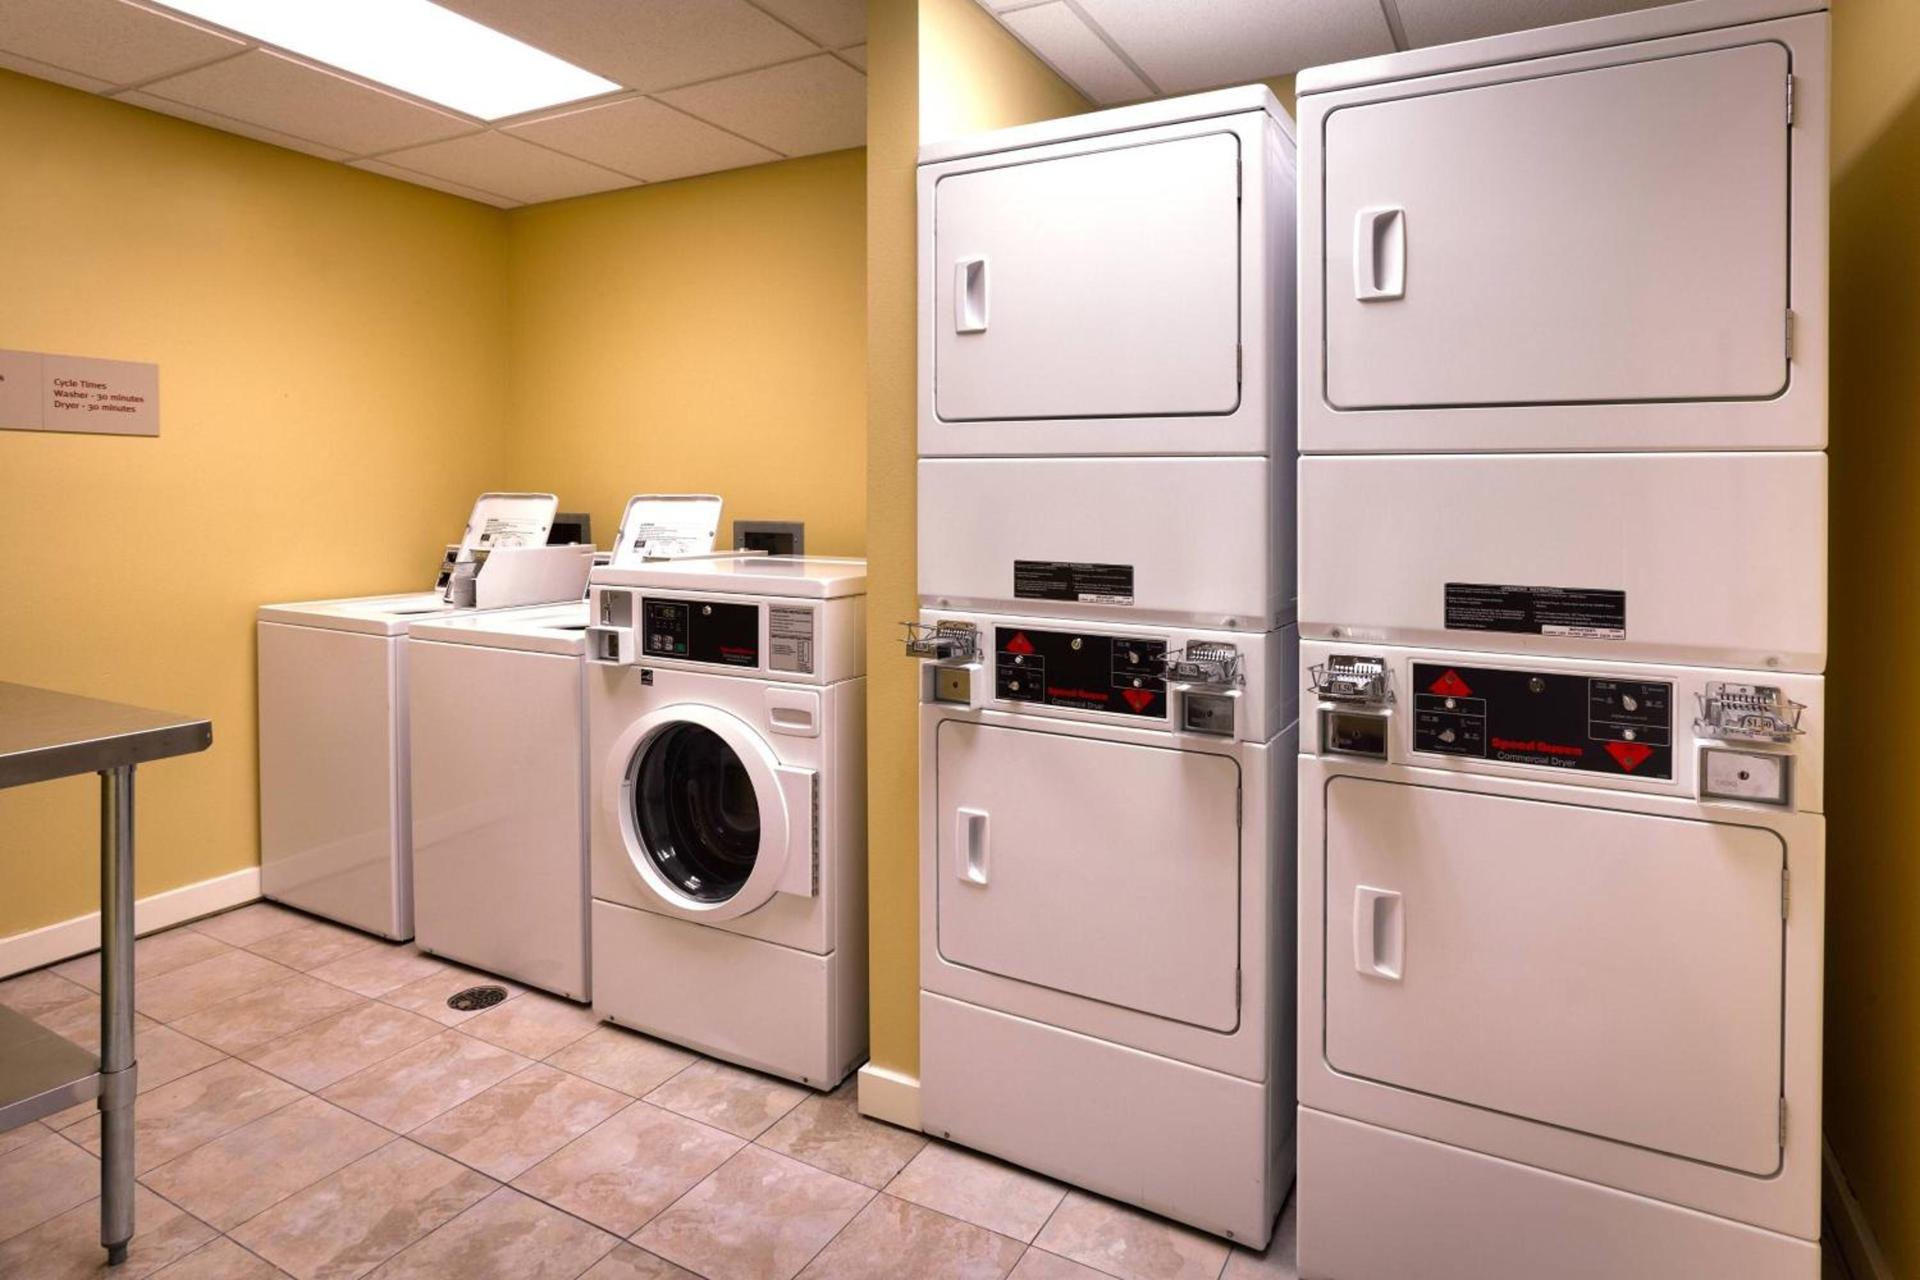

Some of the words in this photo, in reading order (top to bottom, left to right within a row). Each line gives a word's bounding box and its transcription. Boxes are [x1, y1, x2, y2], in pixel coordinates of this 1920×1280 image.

[53, 378, 78, 388] Cycle
[80, 380, 107, 390] Times
[53, 389, 88, 399] Washer
[96, 393, 108, 401] 30
[110, 394, 144, 403] minutes
[54, 400, 79, 410] Dryer
[88, 404, 100, 412] 30
[101, 404, 136, 413] minutes
[1492, 737, 1535, 752] Speed
[1537, 740, 1584, 756] Queen
[1497, 751, 1549, 765] Commercial
[1551, 757, 1577, 768] Dryer
